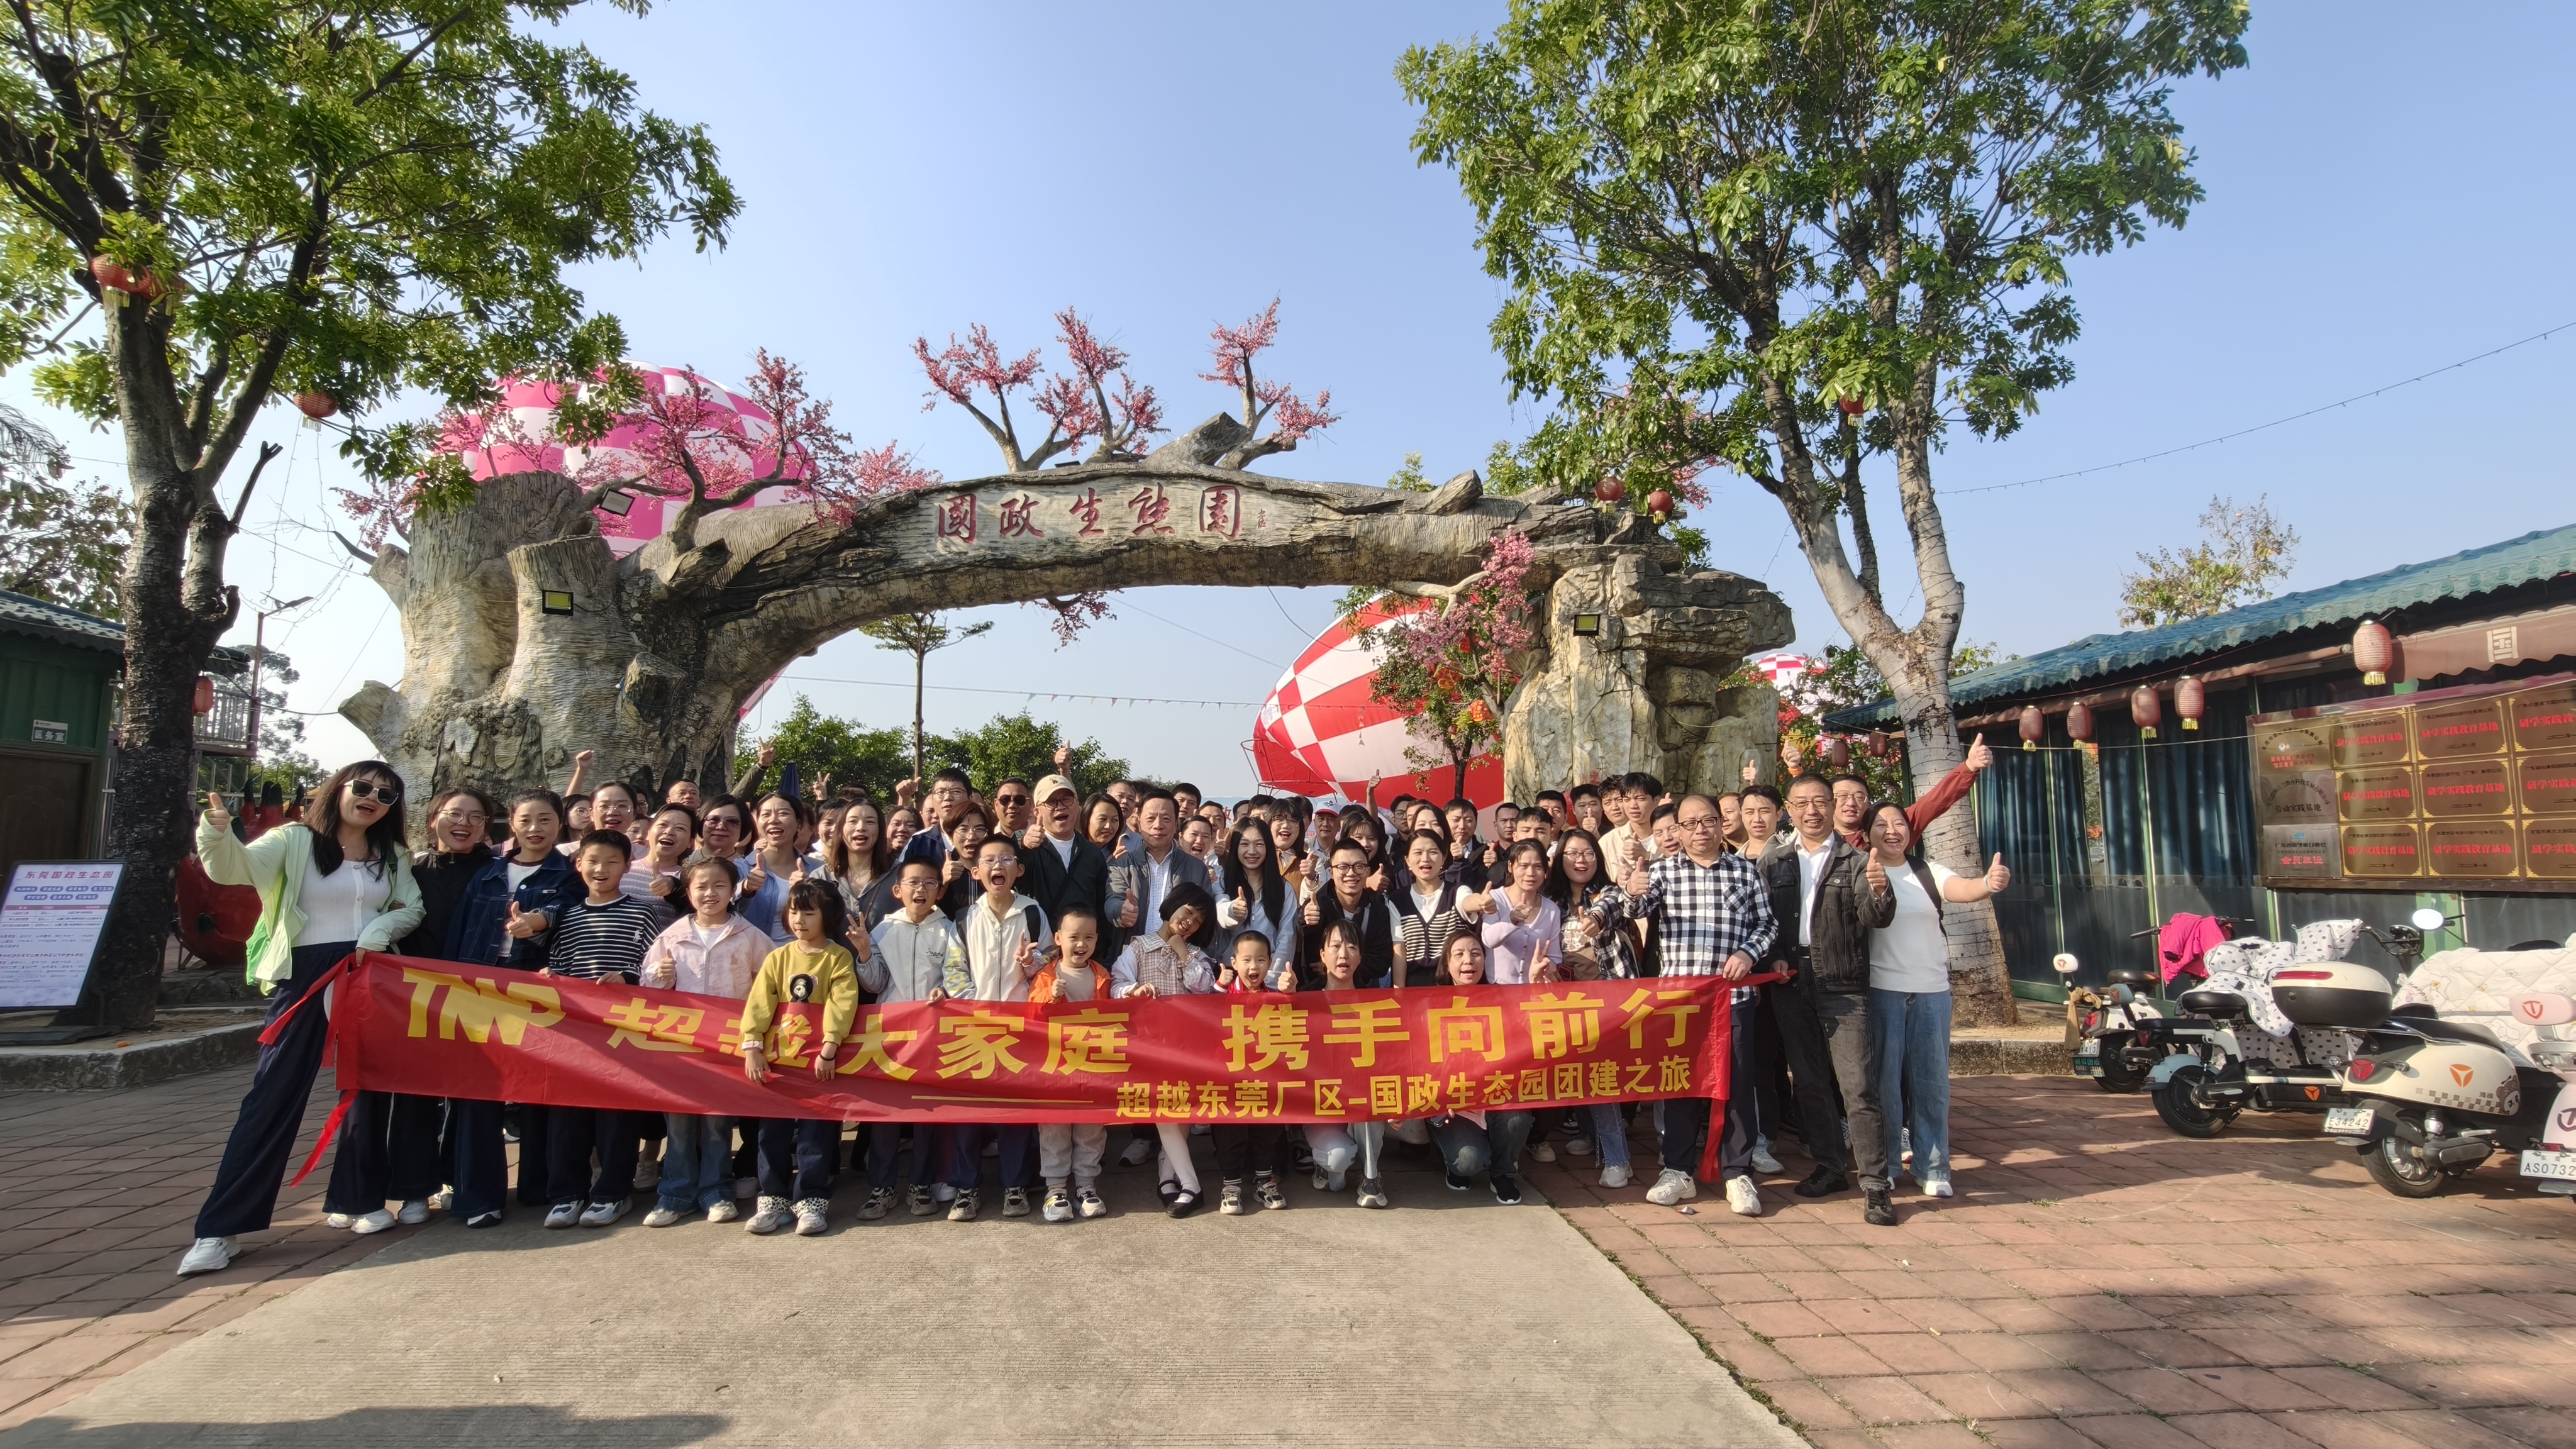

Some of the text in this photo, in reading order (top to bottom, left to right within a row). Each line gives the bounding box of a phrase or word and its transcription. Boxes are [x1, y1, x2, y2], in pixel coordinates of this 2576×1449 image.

[2518, 713, 2576, 728] 研学实践教
[2426, 782, 2505, 796] 研学实践教育基地
[25, 870, 114, 879] 东莞国政生态园
[1219, 989, 1700, 1073] 携手向前行
[1116, 1055, 1690, 1118] 超越东莞厂区-国政生态园团建之旅
[2328, 1117, 2369, 1127] E34242
[2524, 1162, 2575, 1176] AS0732
